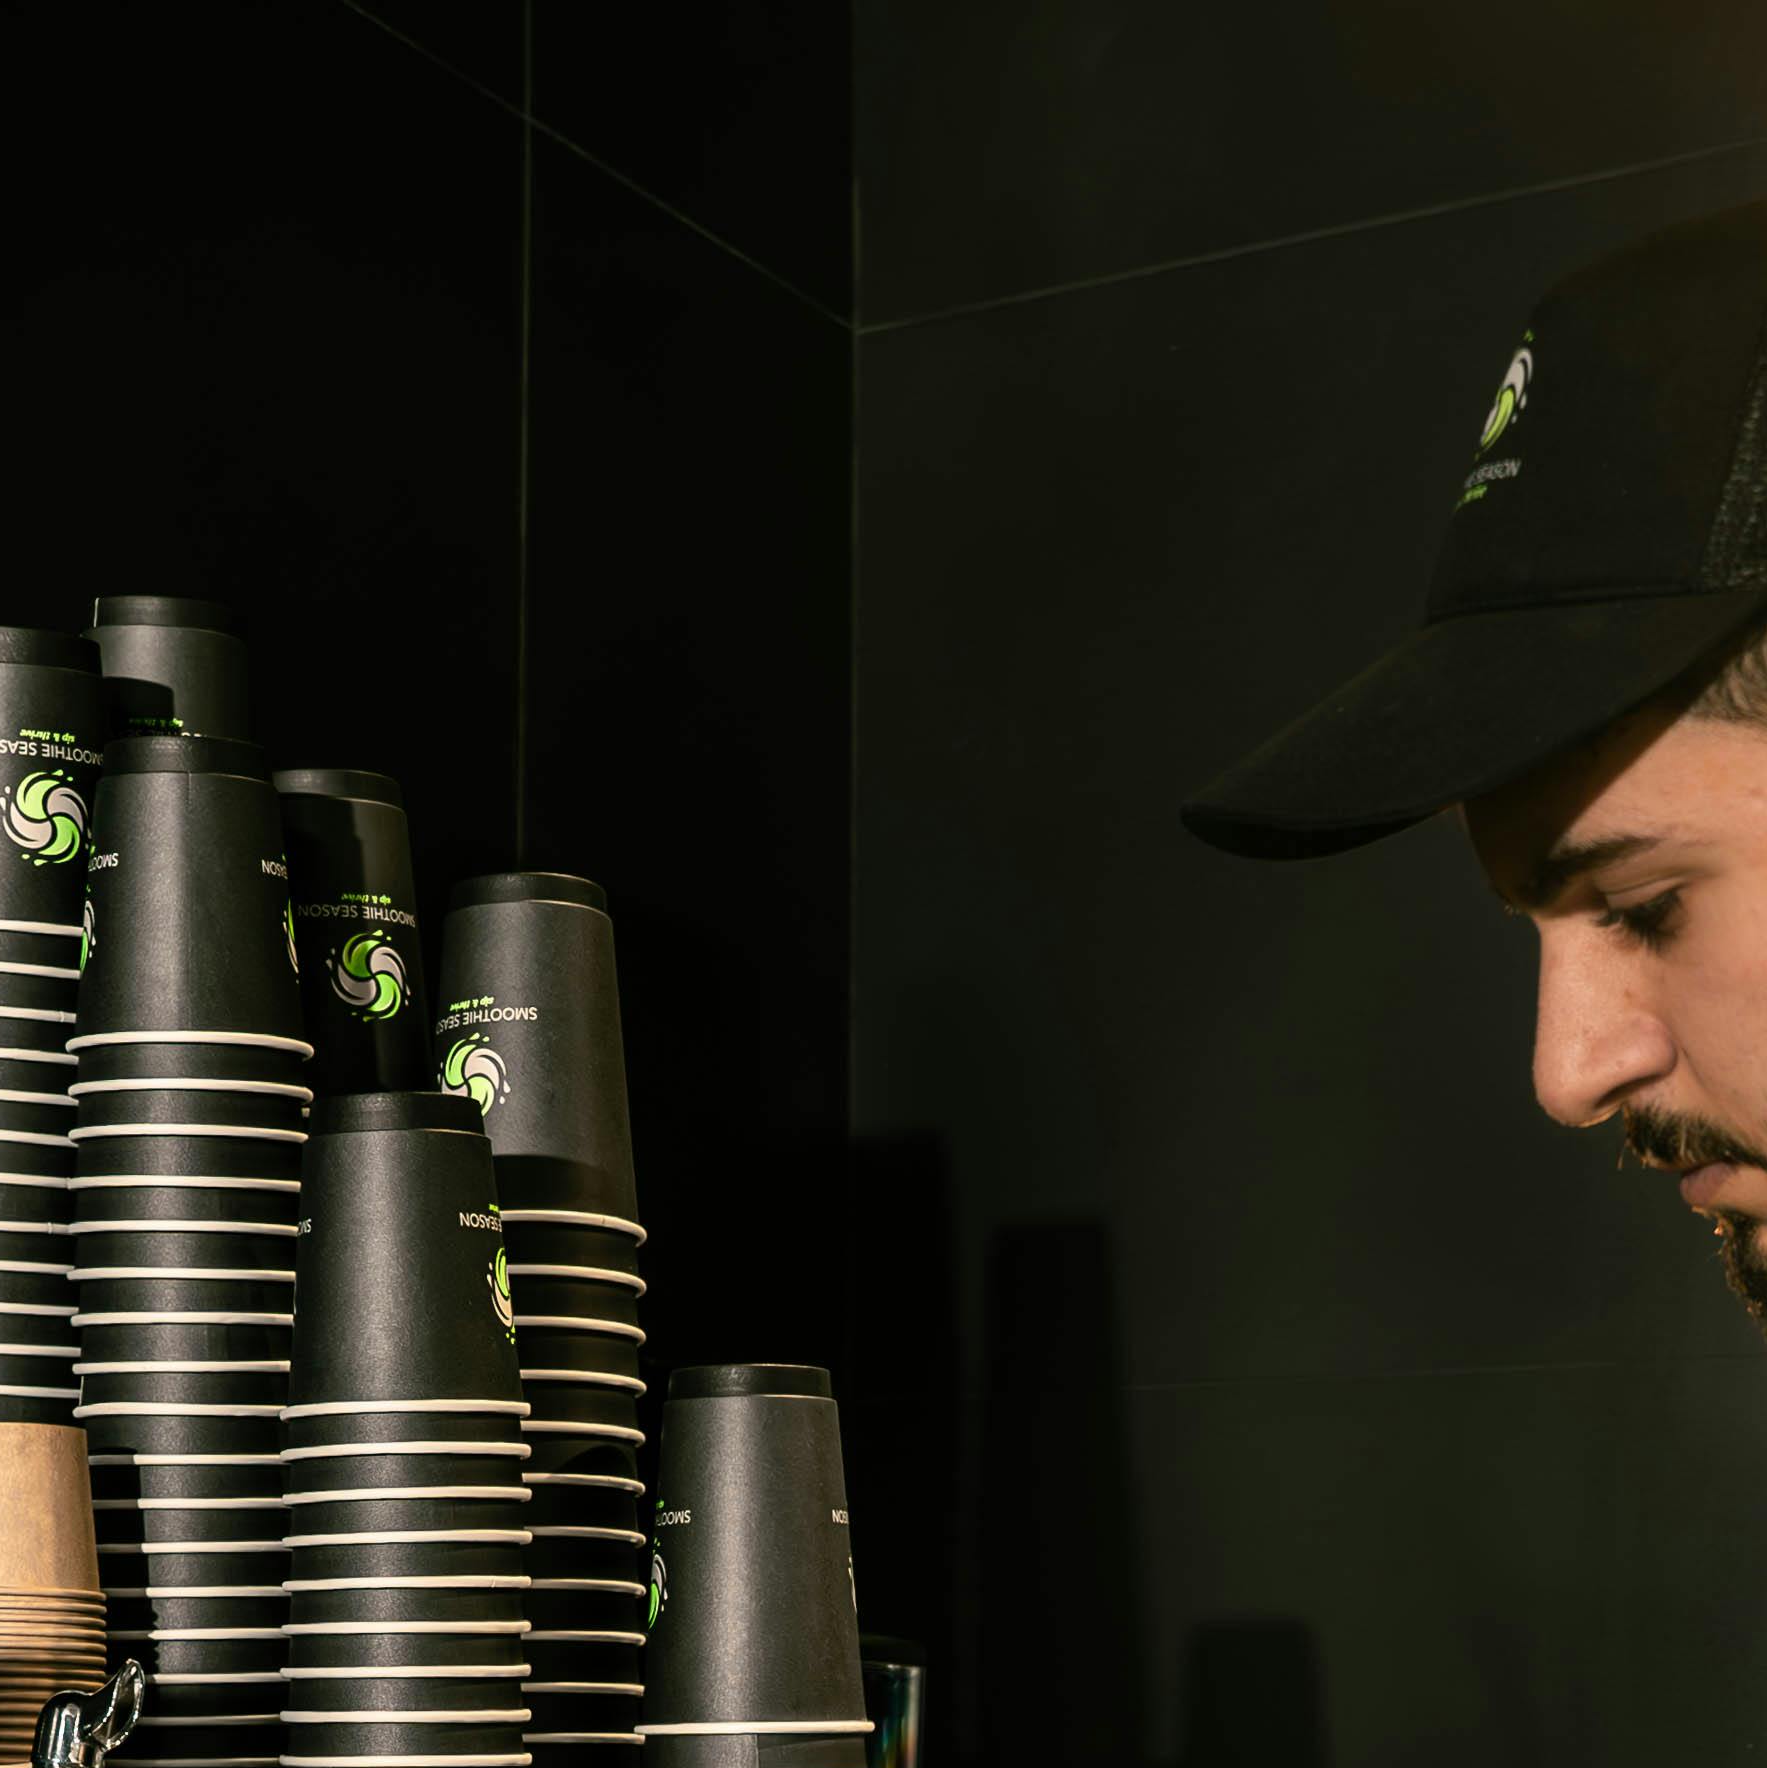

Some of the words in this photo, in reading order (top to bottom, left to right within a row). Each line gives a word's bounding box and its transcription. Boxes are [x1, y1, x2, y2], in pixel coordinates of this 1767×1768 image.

[297, 903, 359, 919] SEASON
[362, 905, 416, 929] SMOOTHIE
[462, 1006, 538, 1026] SMOOTHIE
